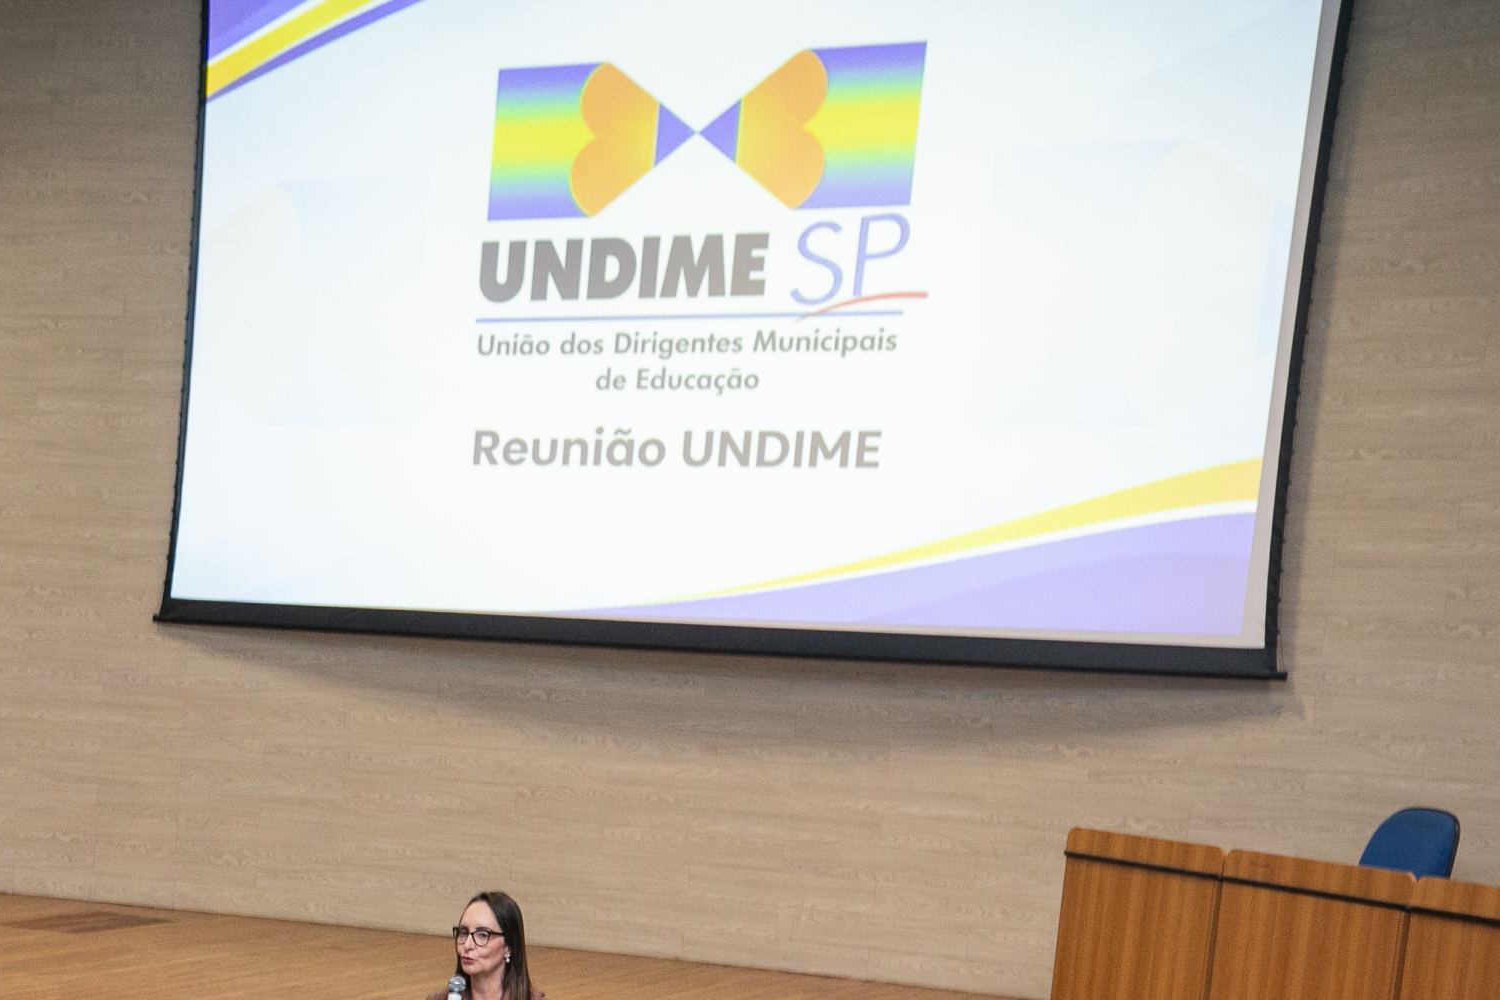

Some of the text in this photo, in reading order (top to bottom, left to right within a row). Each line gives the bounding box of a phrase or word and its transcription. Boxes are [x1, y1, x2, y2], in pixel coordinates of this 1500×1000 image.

[479, 213, 911, 306] UNDIME SP
[476, 327, 898, 360] União dos Dirigentes Municipais
[595, 367, 760, 396] de Educação
[472, 426, 883, 469] Reunião UNDIME
